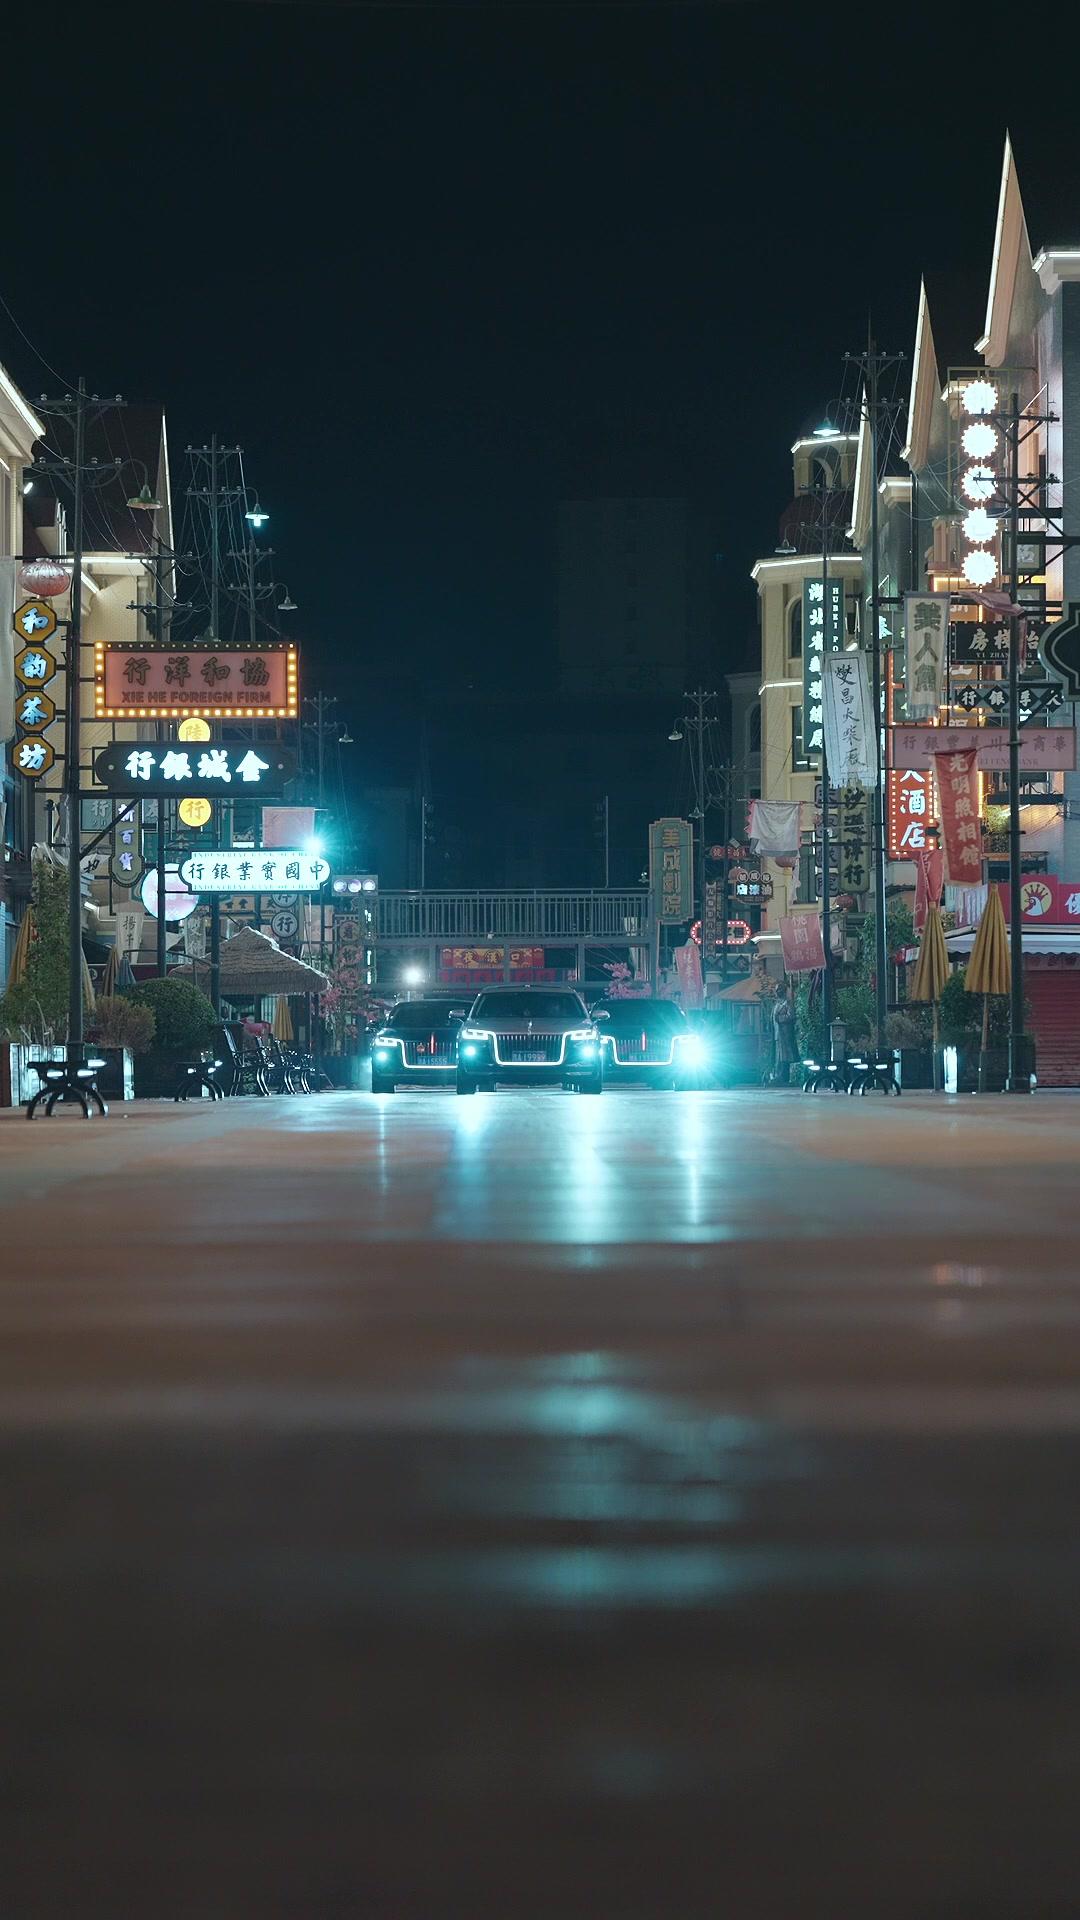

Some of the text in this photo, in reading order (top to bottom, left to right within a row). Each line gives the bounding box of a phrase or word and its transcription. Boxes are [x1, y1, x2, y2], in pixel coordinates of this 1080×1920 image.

[121, 691, 144, 703] XIE
[170, 691, 233, 703] FOREIGN
[236, 691, 271, 703] FIRM
